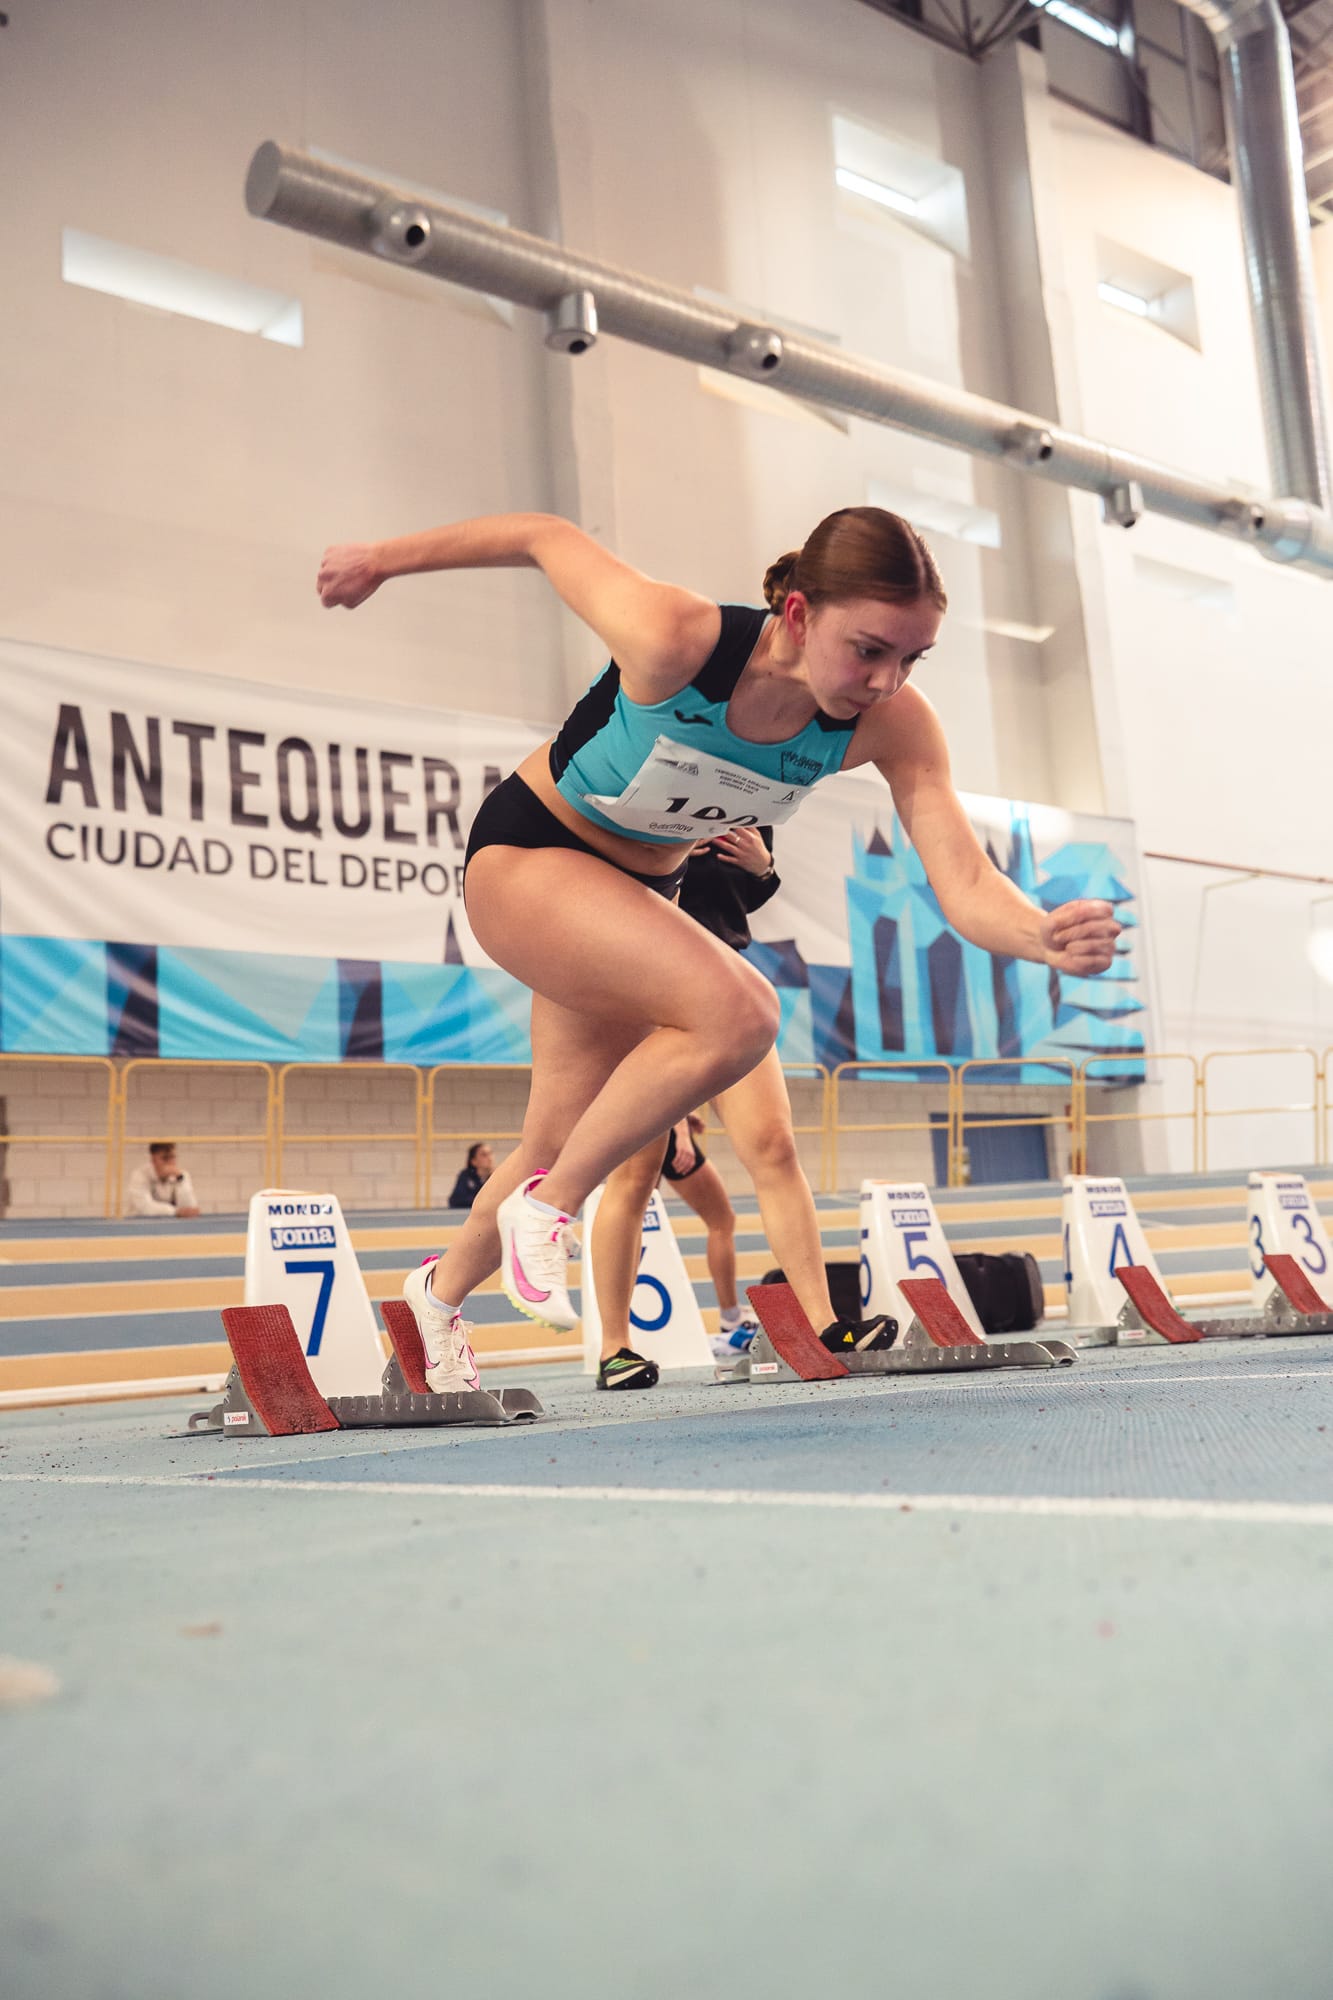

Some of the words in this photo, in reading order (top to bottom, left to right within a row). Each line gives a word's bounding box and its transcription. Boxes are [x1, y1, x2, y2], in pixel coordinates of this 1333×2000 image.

[46, 703, 503, 850] ANTEQUER
[46, 822, 233, 875] CIUDAD
[249, 844, 328, 886] DEL
[1292, 1213, 1326, 1275] 3
[285, 1260, 336, 1357] 7
